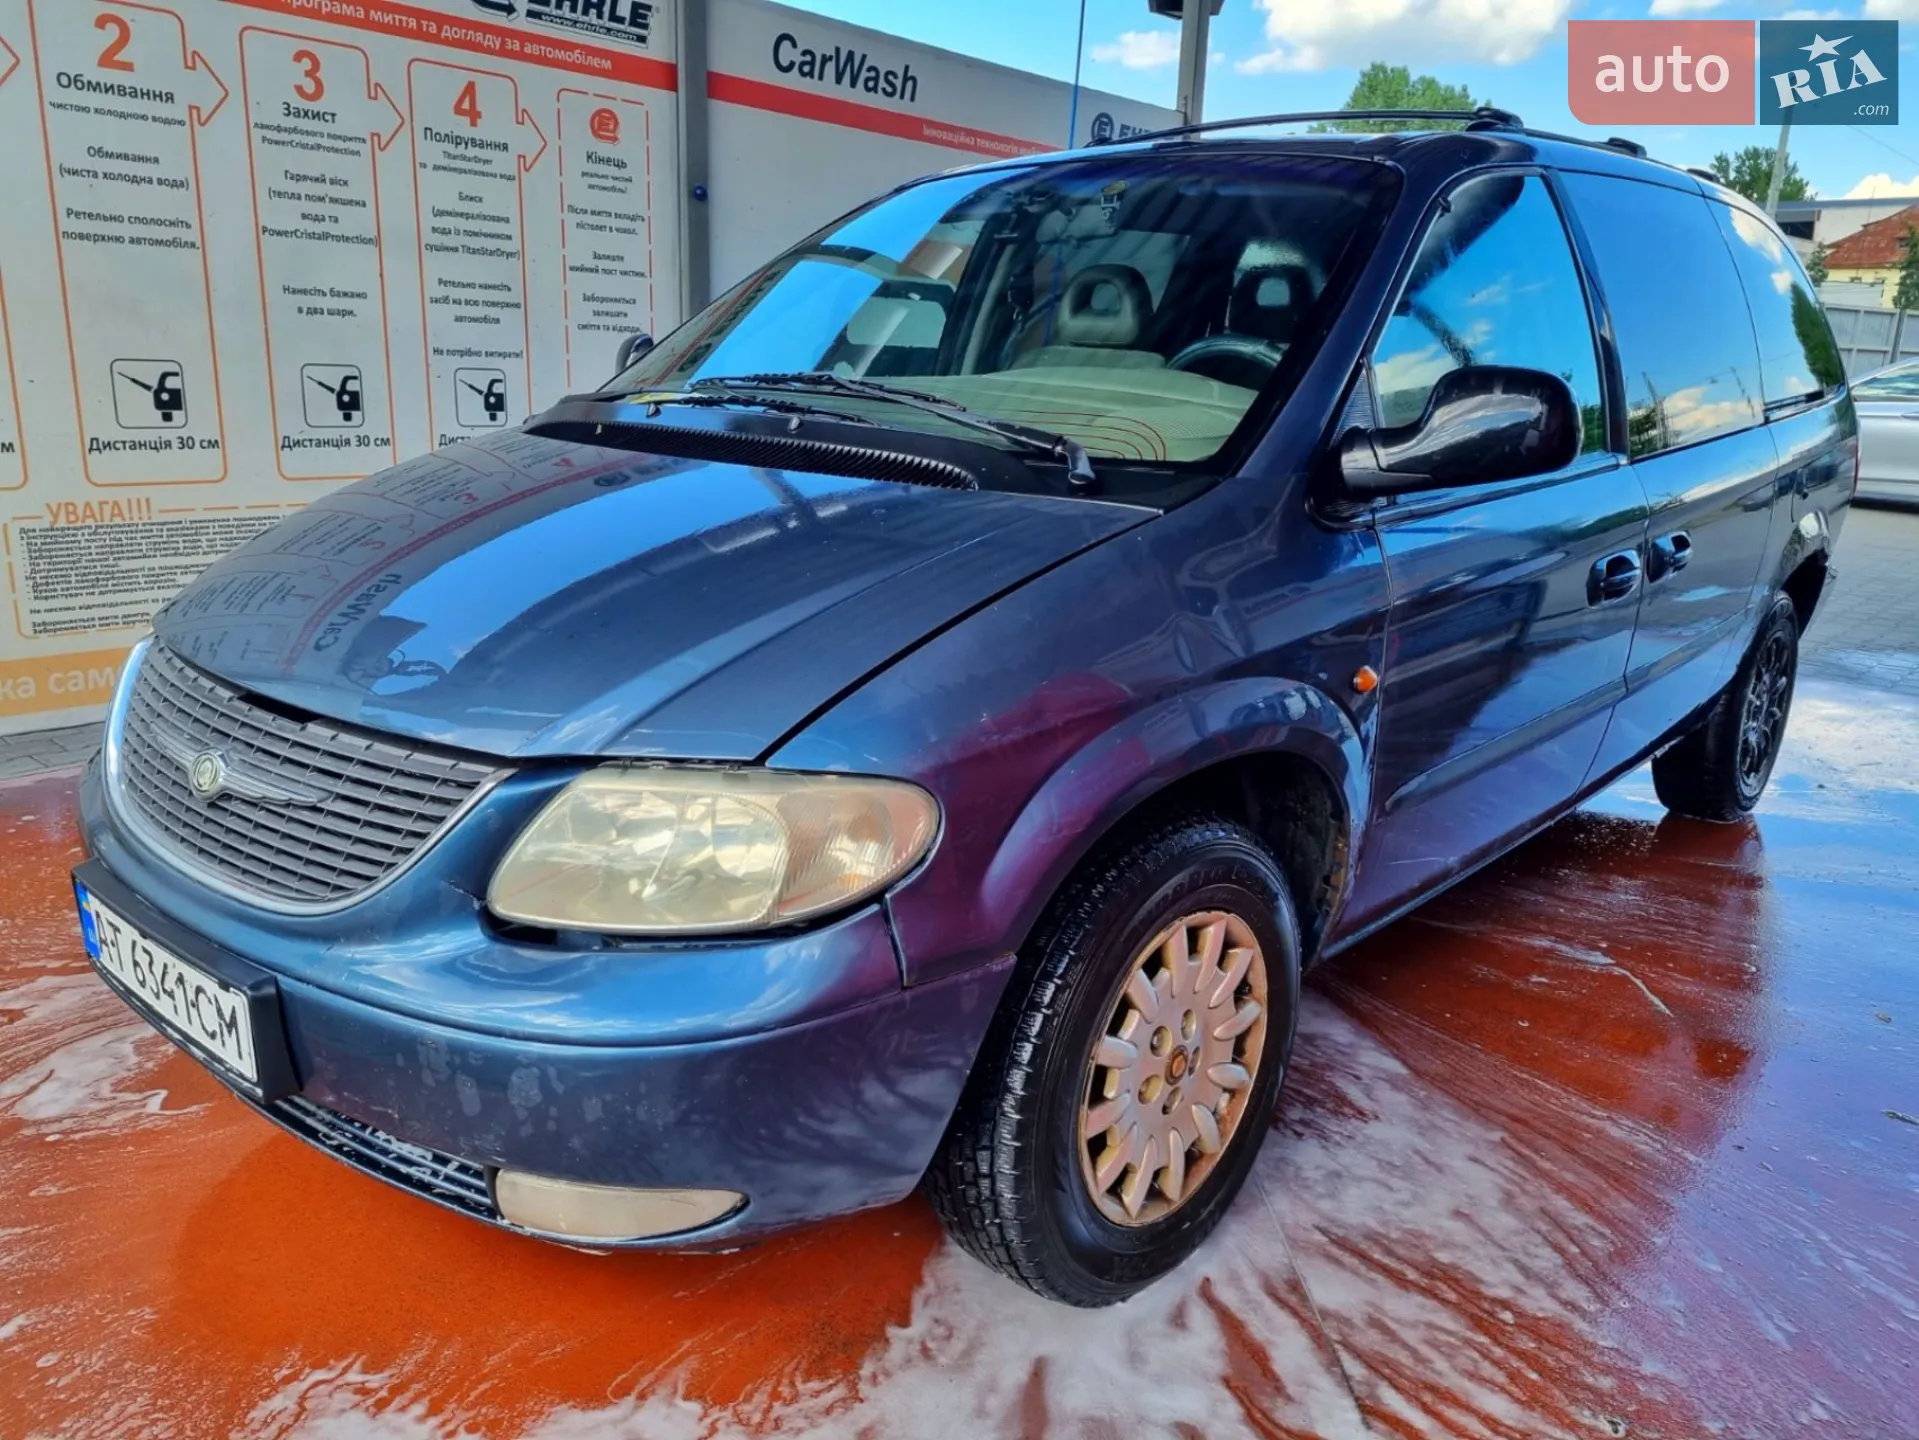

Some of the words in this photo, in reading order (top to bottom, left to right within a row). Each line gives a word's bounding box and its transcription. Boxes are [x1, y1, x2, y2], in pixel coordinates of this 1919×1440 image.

[541, 14, 637, 41] www.ehrle.com
[94, 13, 135, 72] 2
[370, 12, 417, 30] миття
[421, 20, 437, 34] та
[441, 25, 502, 49] догляду
[505, 37, 520, 51] за
[524, 42, 612, 70] автомобілем
[292, 50, 324, 102] 3
[772, 32, 918, 102] CarWash
[56, 72, 175, 104] Обмивання
[49, 100, 91, 114] чистою
[93, 107, 149, 122] холодною
[151, 116, 186, 127] водою
[282, 101, 337, 124] Захист
[453, 80, 482, 127] 4
[253, 121, 325, 138] лакофарбового
[327, 132, 366, 144] покриття
[424, 127, 509, 153] Полірування
[87, 146, 160, 165] Обмивання
[261, 136, 361, 157] PowerCristalProtection
[586, 150, 627, 170] Кінець
[59, 164, 99, 179] (чиста
[102, 171, 154, 185] холодна
[156, 177, 190, 190] вода)
[284, 170, 327, 184] Гарячий
[329, 176, 349, 187] віск
[268, 187, 302, 201] (тепла
[66, 207, 125, 223] Ретельно
[127, 215, 192, 229] сполосніть
[301, 213, 326, 224] вода
[328, 215, 339, 224] та
[62, 230, 125, 244] поверхню
[128, 237, 200, 250] автомобіля.
[262, 226, 378, 247] PowerCristalProtection)
[282, 285, 327, 298] Нанесіть
[329, 287, 368, 299] бажано
[437, 278, 476, 289] Ретельно
[306, 307, 324, 316] два
[327, 307, 357, 318] шари.
[433, 347, 444, 356] Не
[88, 437, 172, 455] Дистанція
[177, 437, 195, 450] 30
[199, 439, 220, 449] см
[281, 435, 351, 451] Дистанція
[356, 436, 370, 447] 30
[374, 437, 391, 447] см
[45, 498, 152, 526] УВАГА!!!
[131, 939, 193, 1027] 6341
